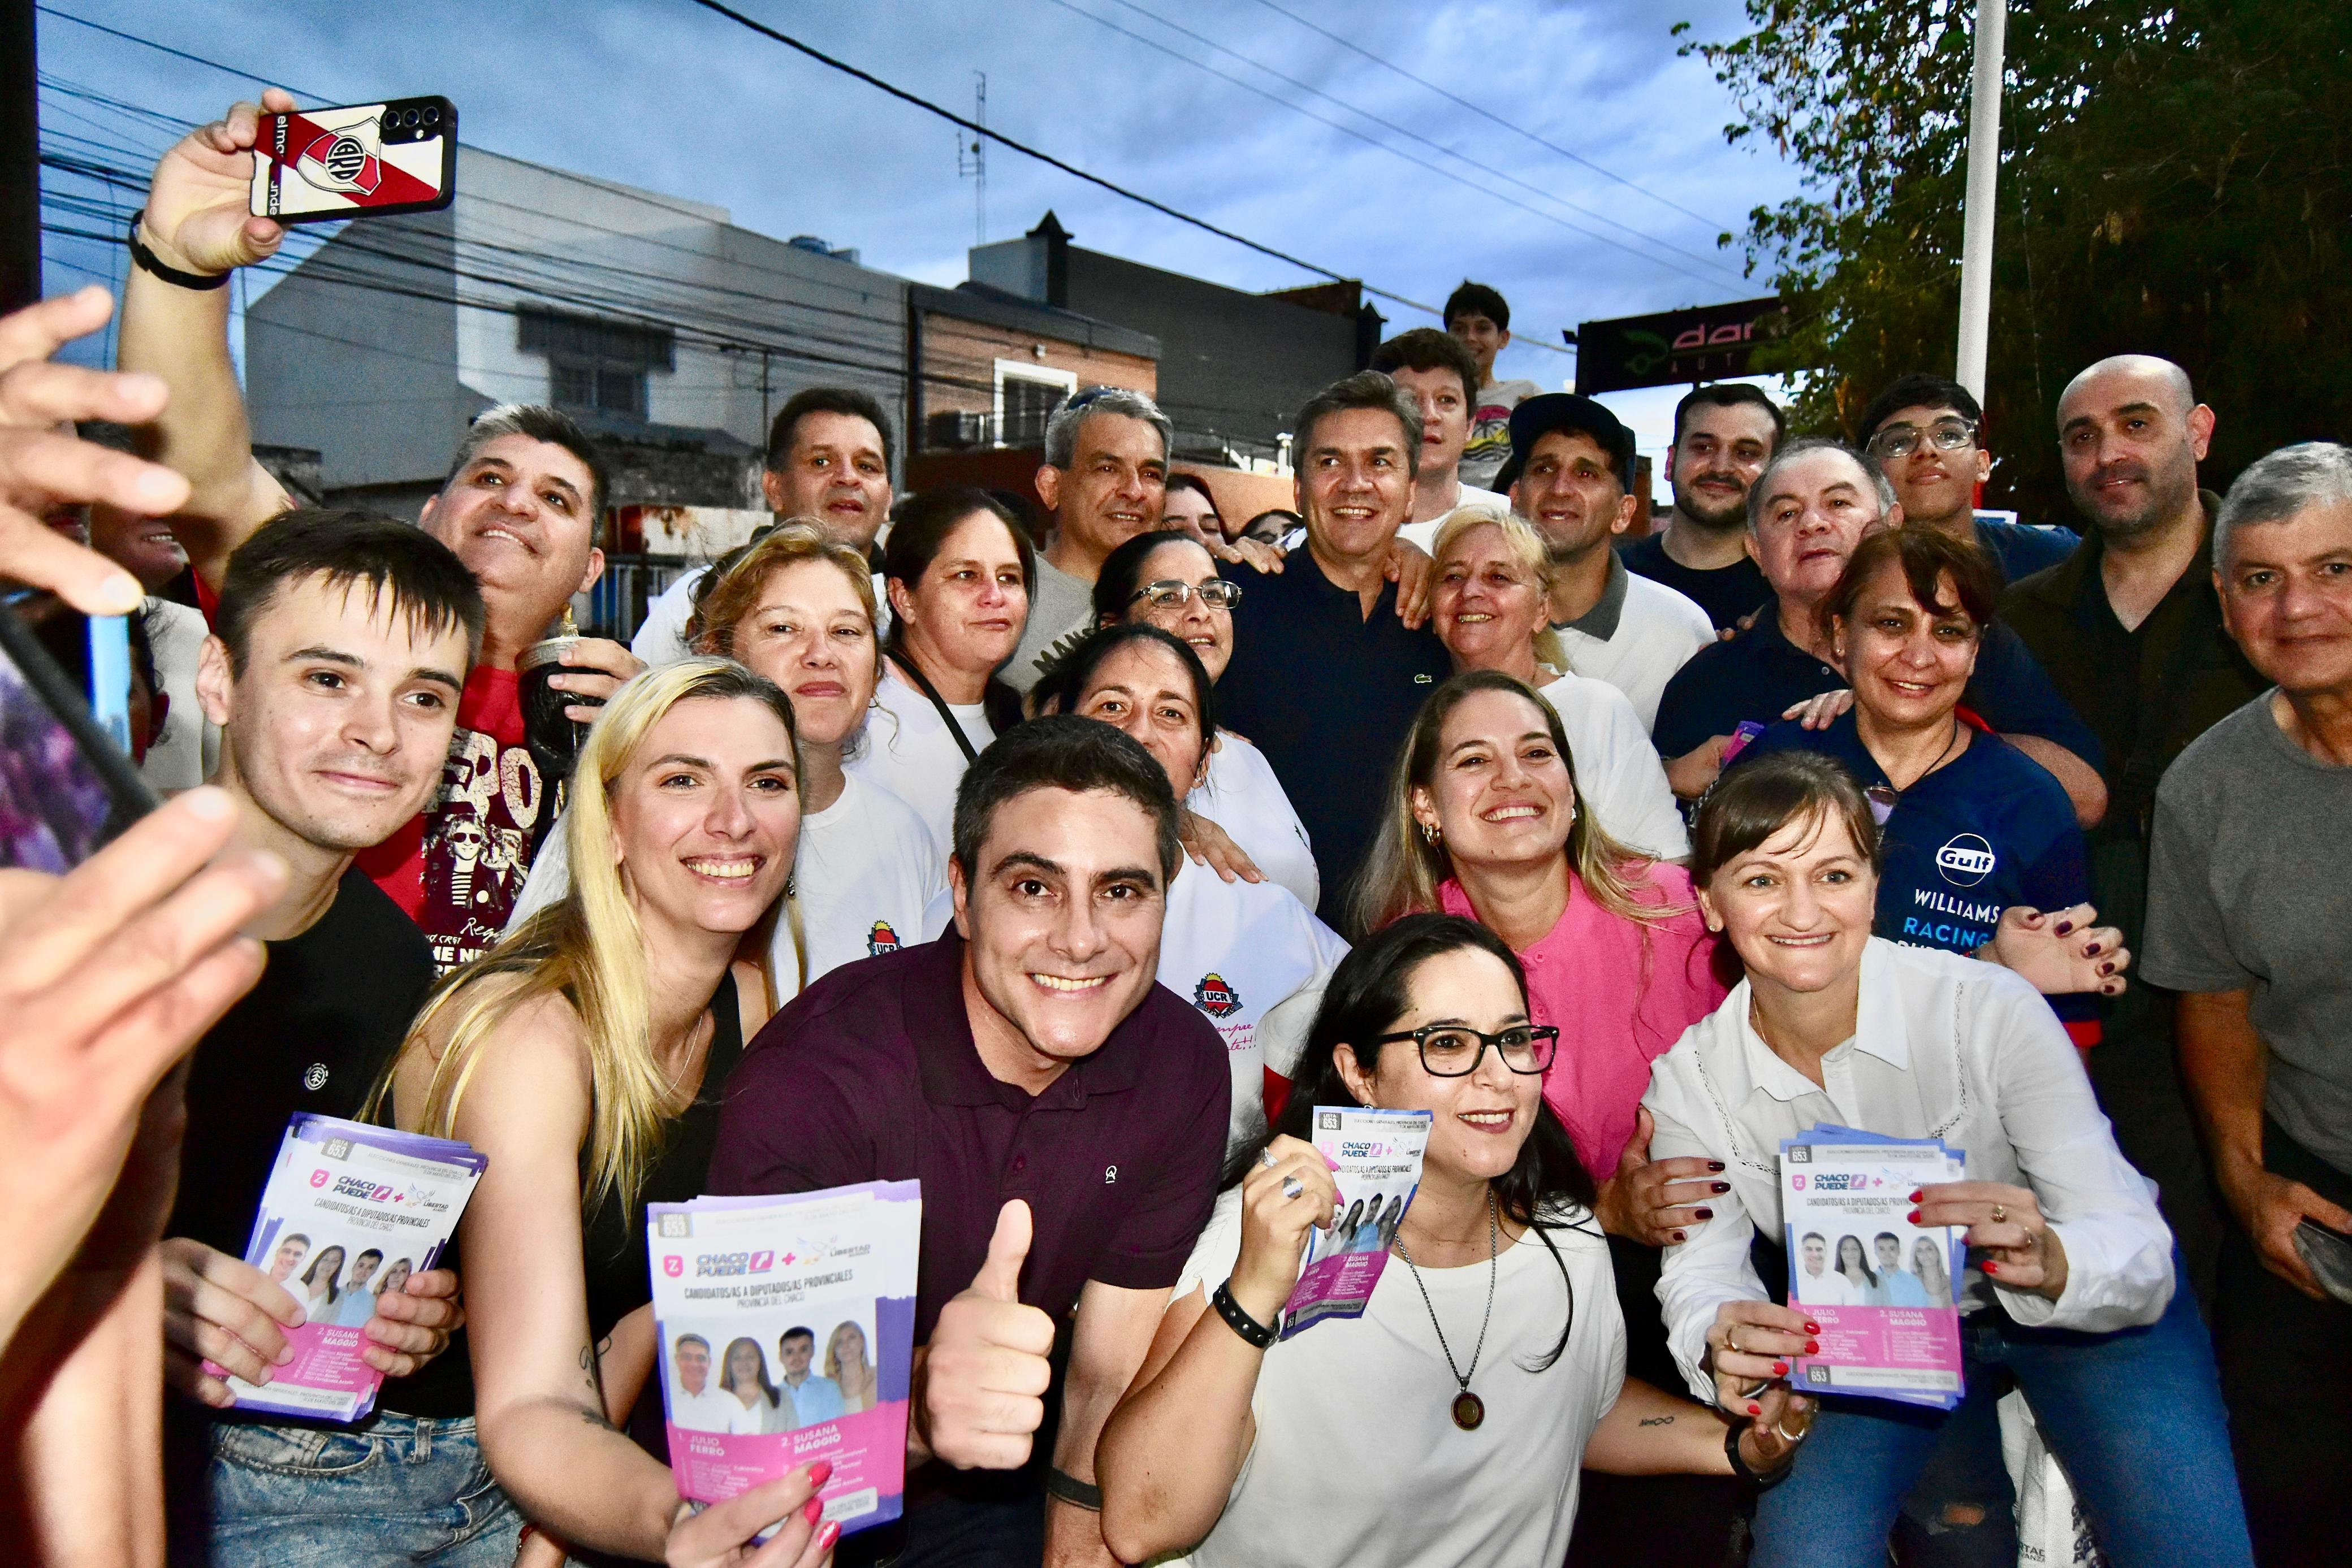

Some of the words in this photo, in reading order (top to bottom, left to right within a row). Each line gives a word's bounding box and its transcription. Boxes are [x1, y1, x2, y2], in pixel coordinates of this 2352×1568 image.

[1940, 849, 1991, 870] Gulf
[1915, 889, 2000, 924] WILLIAMS
[1903, 916, 1989, 948] RACING
[1206, 992, 1228, 1002] UCR
[1323, 1118, 1337, 1129] 653
[327, 1143, 347, 1158] 653
[1792, 1151, 1807, 1162] 653
[338, 1176, 377, 1191] CHACO
[332, 1185, 372, 1199] PUEDE
[314, 1197, 357, 1215] CANDIDATOS/AS
[396, 1215, 430, 1228] PROVINCIALES
[423, 1201, 449, 1210] LIBERTAD
[347, 1215, 370, 1227] PROVINCIA
[696, 1252, 750, 1266] CHACO
[696, 1264, 748, 1277] PUEDE
[684, 1286, 741, 1300] CANDIDATOS/AS
[803, 1269, 854, 1289] PROVINCIALES
[326, 1328, 360, 1340] SUSANA
[321, 1336, 358, 1348] MAGGIO
[1810, 1371, 1827, 1383] 653
[692, 1435, 720, 1446] JULIO
[793, 1424, 838, 1444] SUSANA
[690, 1443, 725, 1457] FERRO
[794, 1433, 841, 1454] MAGGIO
